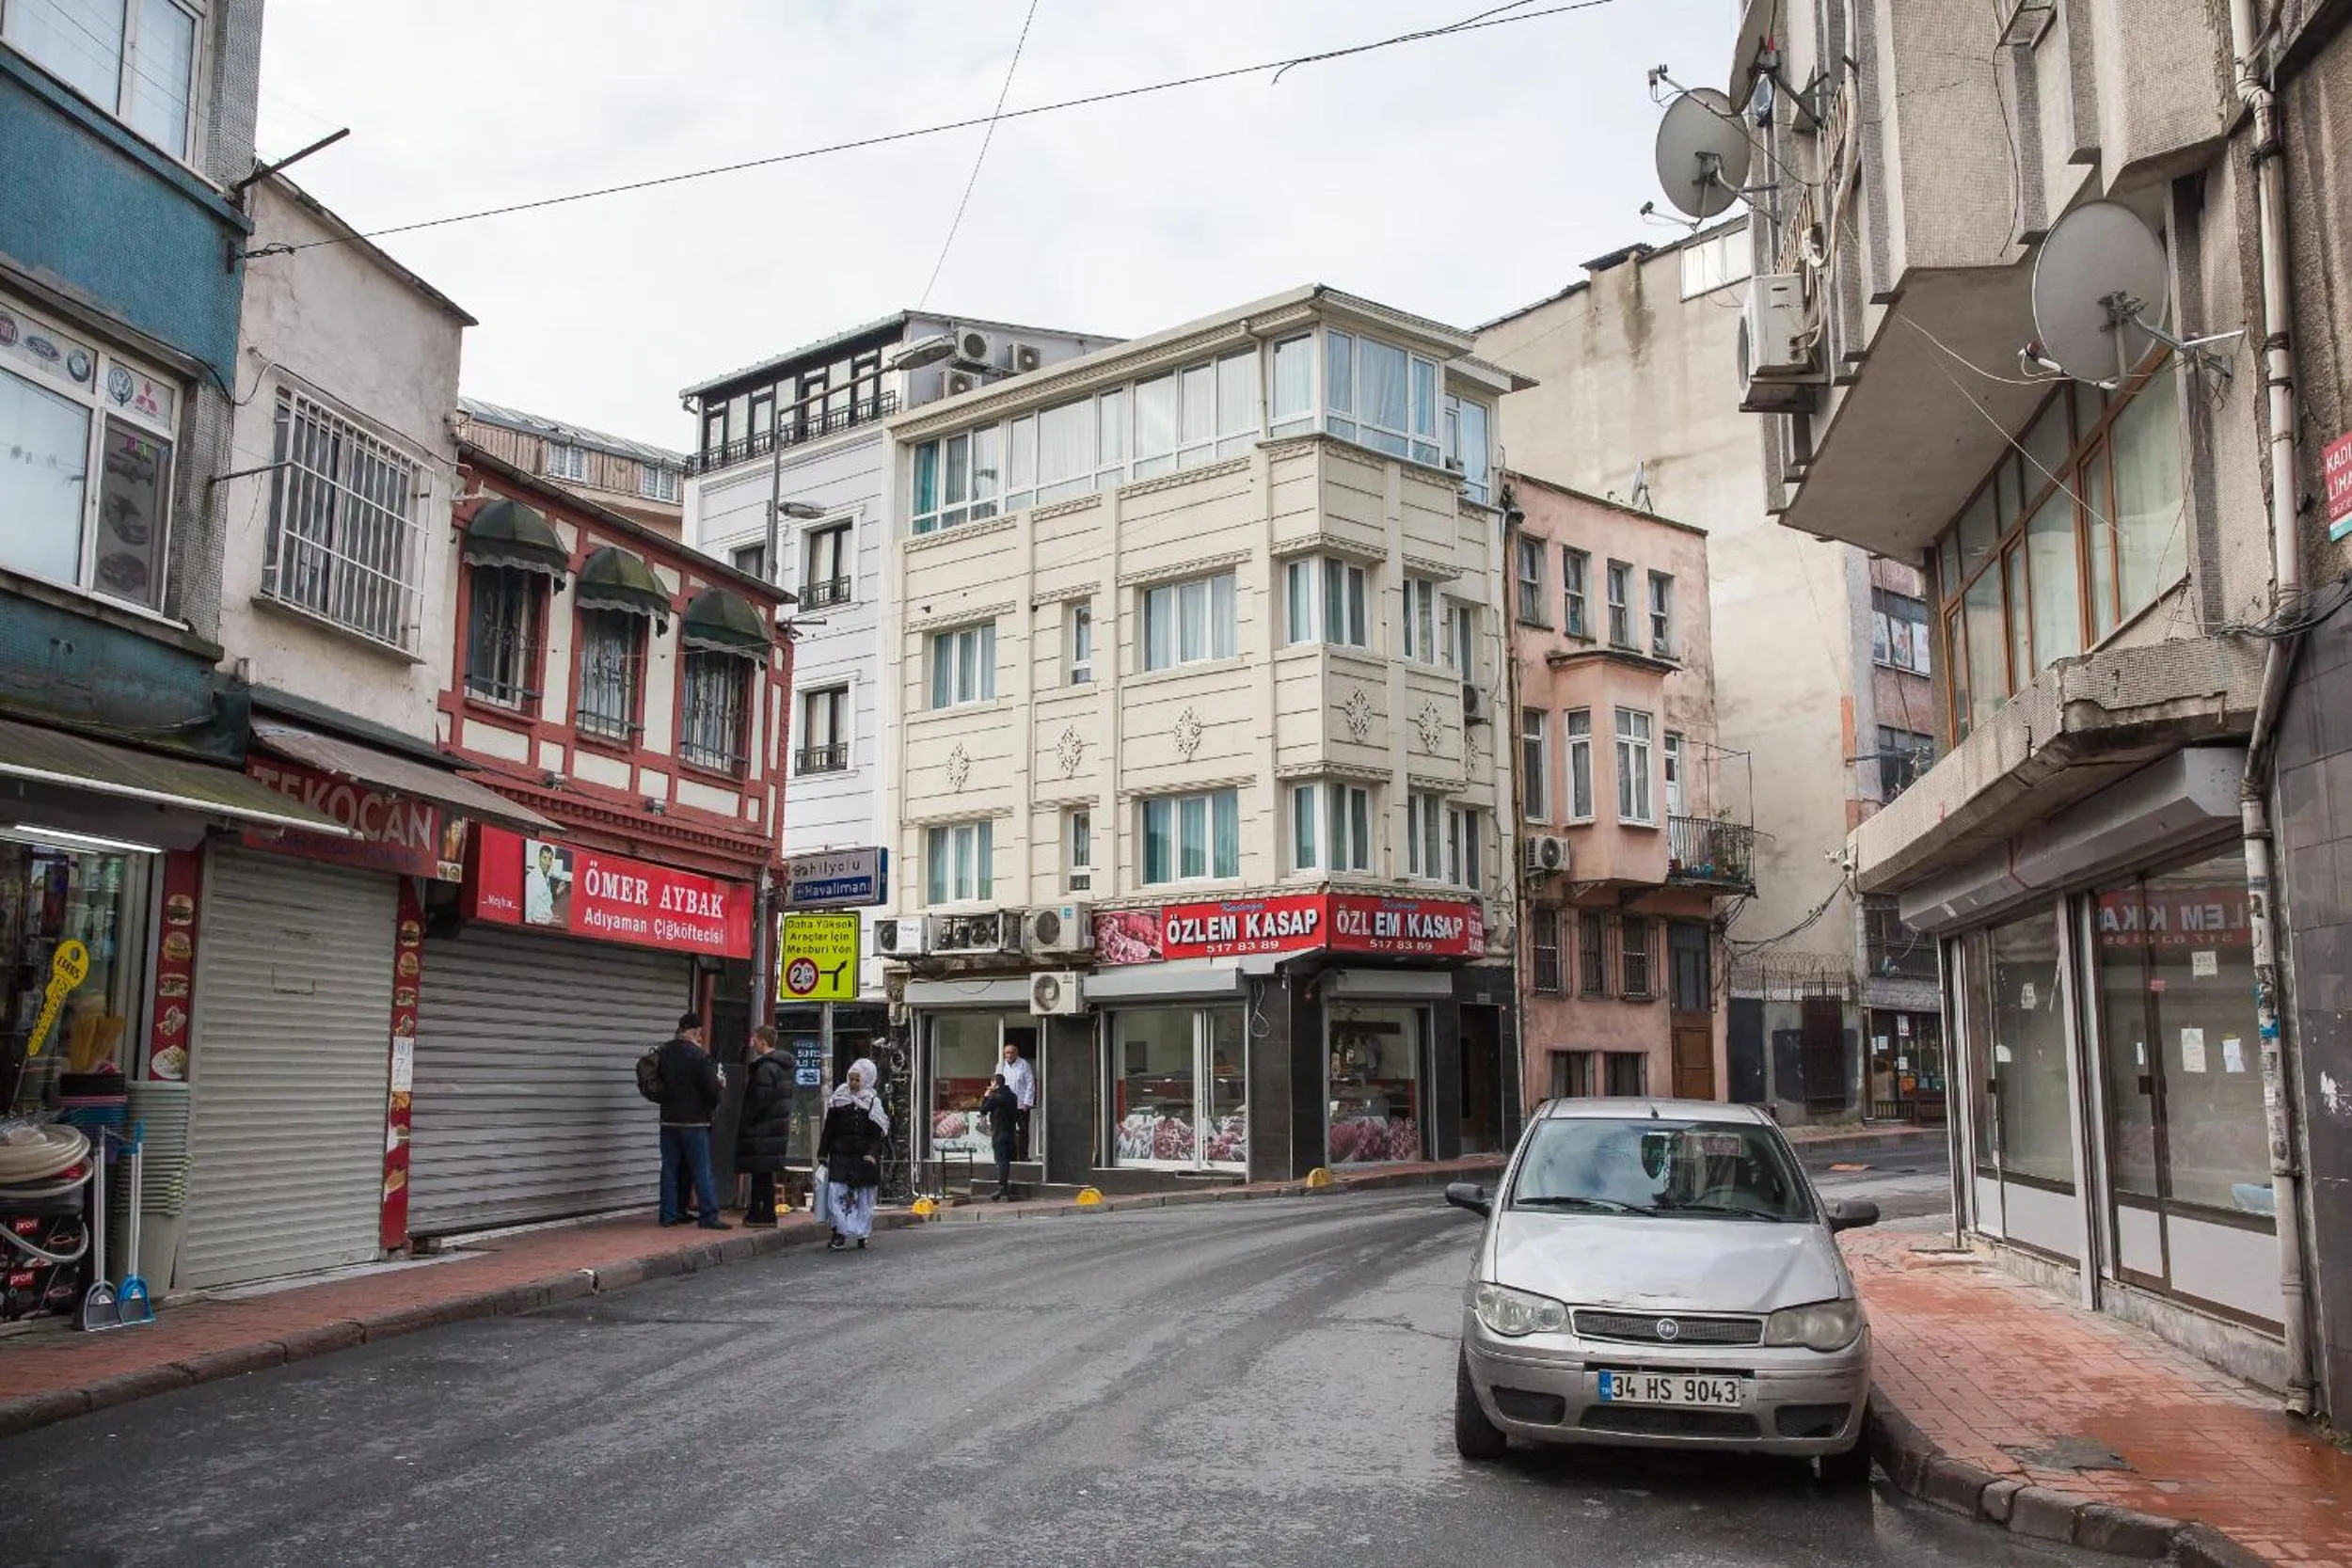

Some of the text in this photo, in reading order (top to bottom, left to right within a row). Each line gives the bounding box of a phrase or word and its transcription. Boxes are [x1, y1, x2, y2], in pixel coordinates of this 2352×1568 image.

[584, 860, 723, 919] ÖMER AYBAK
[583, 907, 647, 934] Adıyaman
[1166, 909, 1319, 945] ÖZLEM KASAP
[1336, 903, 1401, 937] ÖZLEM
[1406, 913, 1464, 939] KASAP
[1206, 942, 1232, 953] 517
[1238, 942, 1256, 952] 83
[1370, 939, 1391, 949] 517
[1396, 941, 1413, 950] 83
[792, 967, 803, 984] 2
[1613, 1376, 1636, 1398] 34
[1647, 1378, 1672, 1400] HS
[1684, 1380, 1737, 1403] 9043
